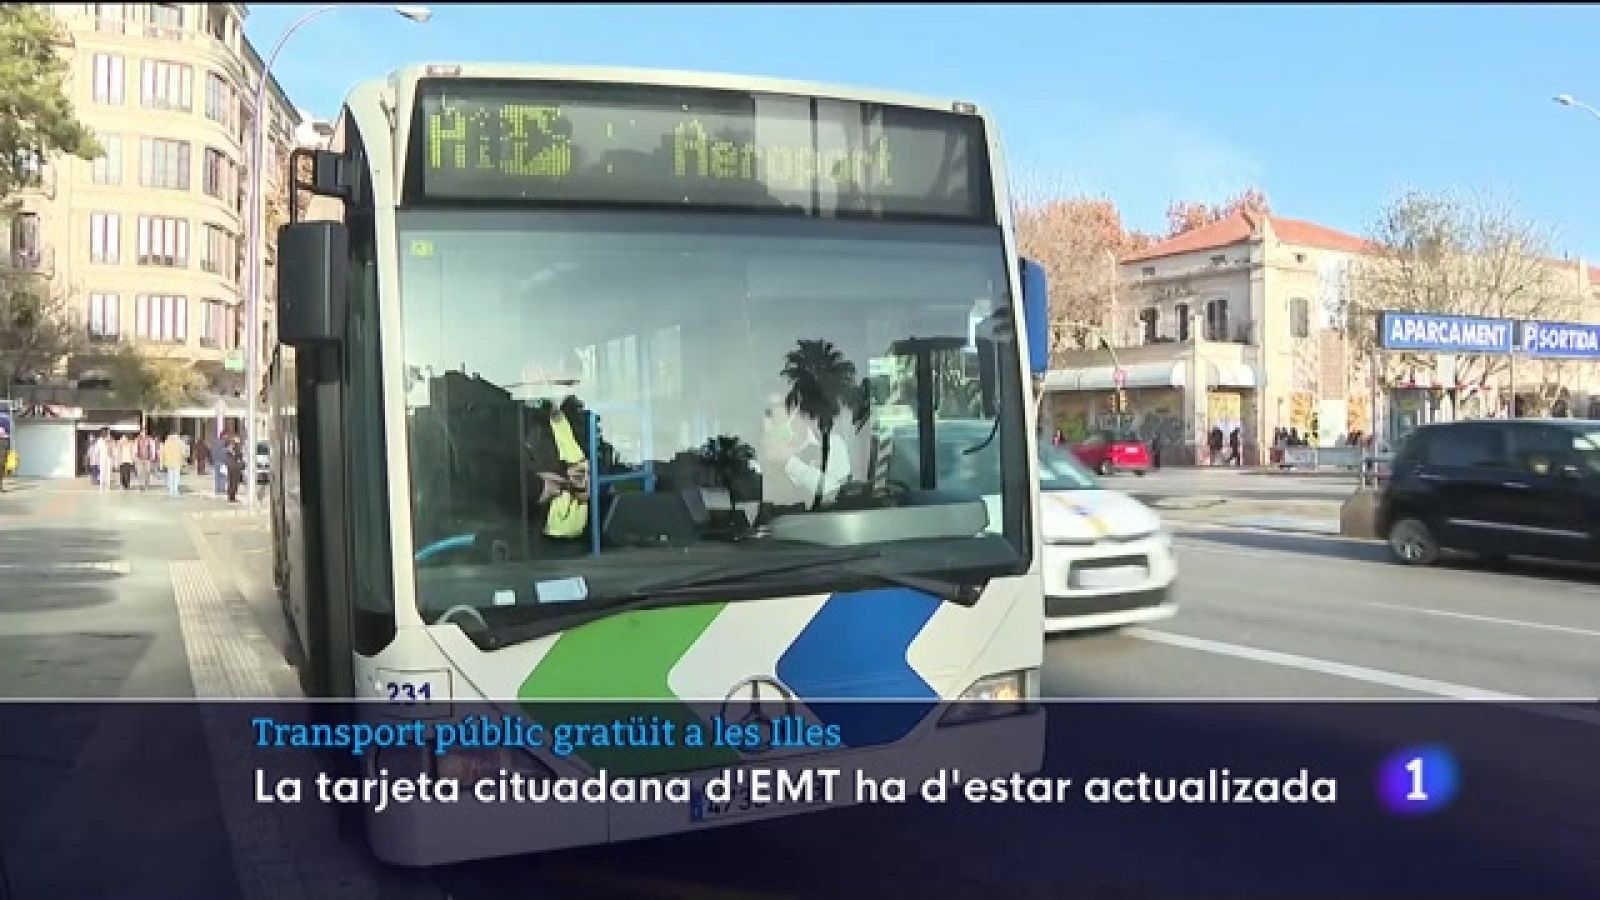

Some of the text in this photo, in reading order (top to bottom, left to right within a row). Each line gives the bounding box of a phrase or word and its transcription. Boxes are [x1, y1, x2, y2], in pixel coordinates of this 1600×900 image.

[1390, 317, 1507, 347] APARCAMENT
[1539, 328, 1599, 351] SORTIDA
[386, 681, 431, 705] 231
